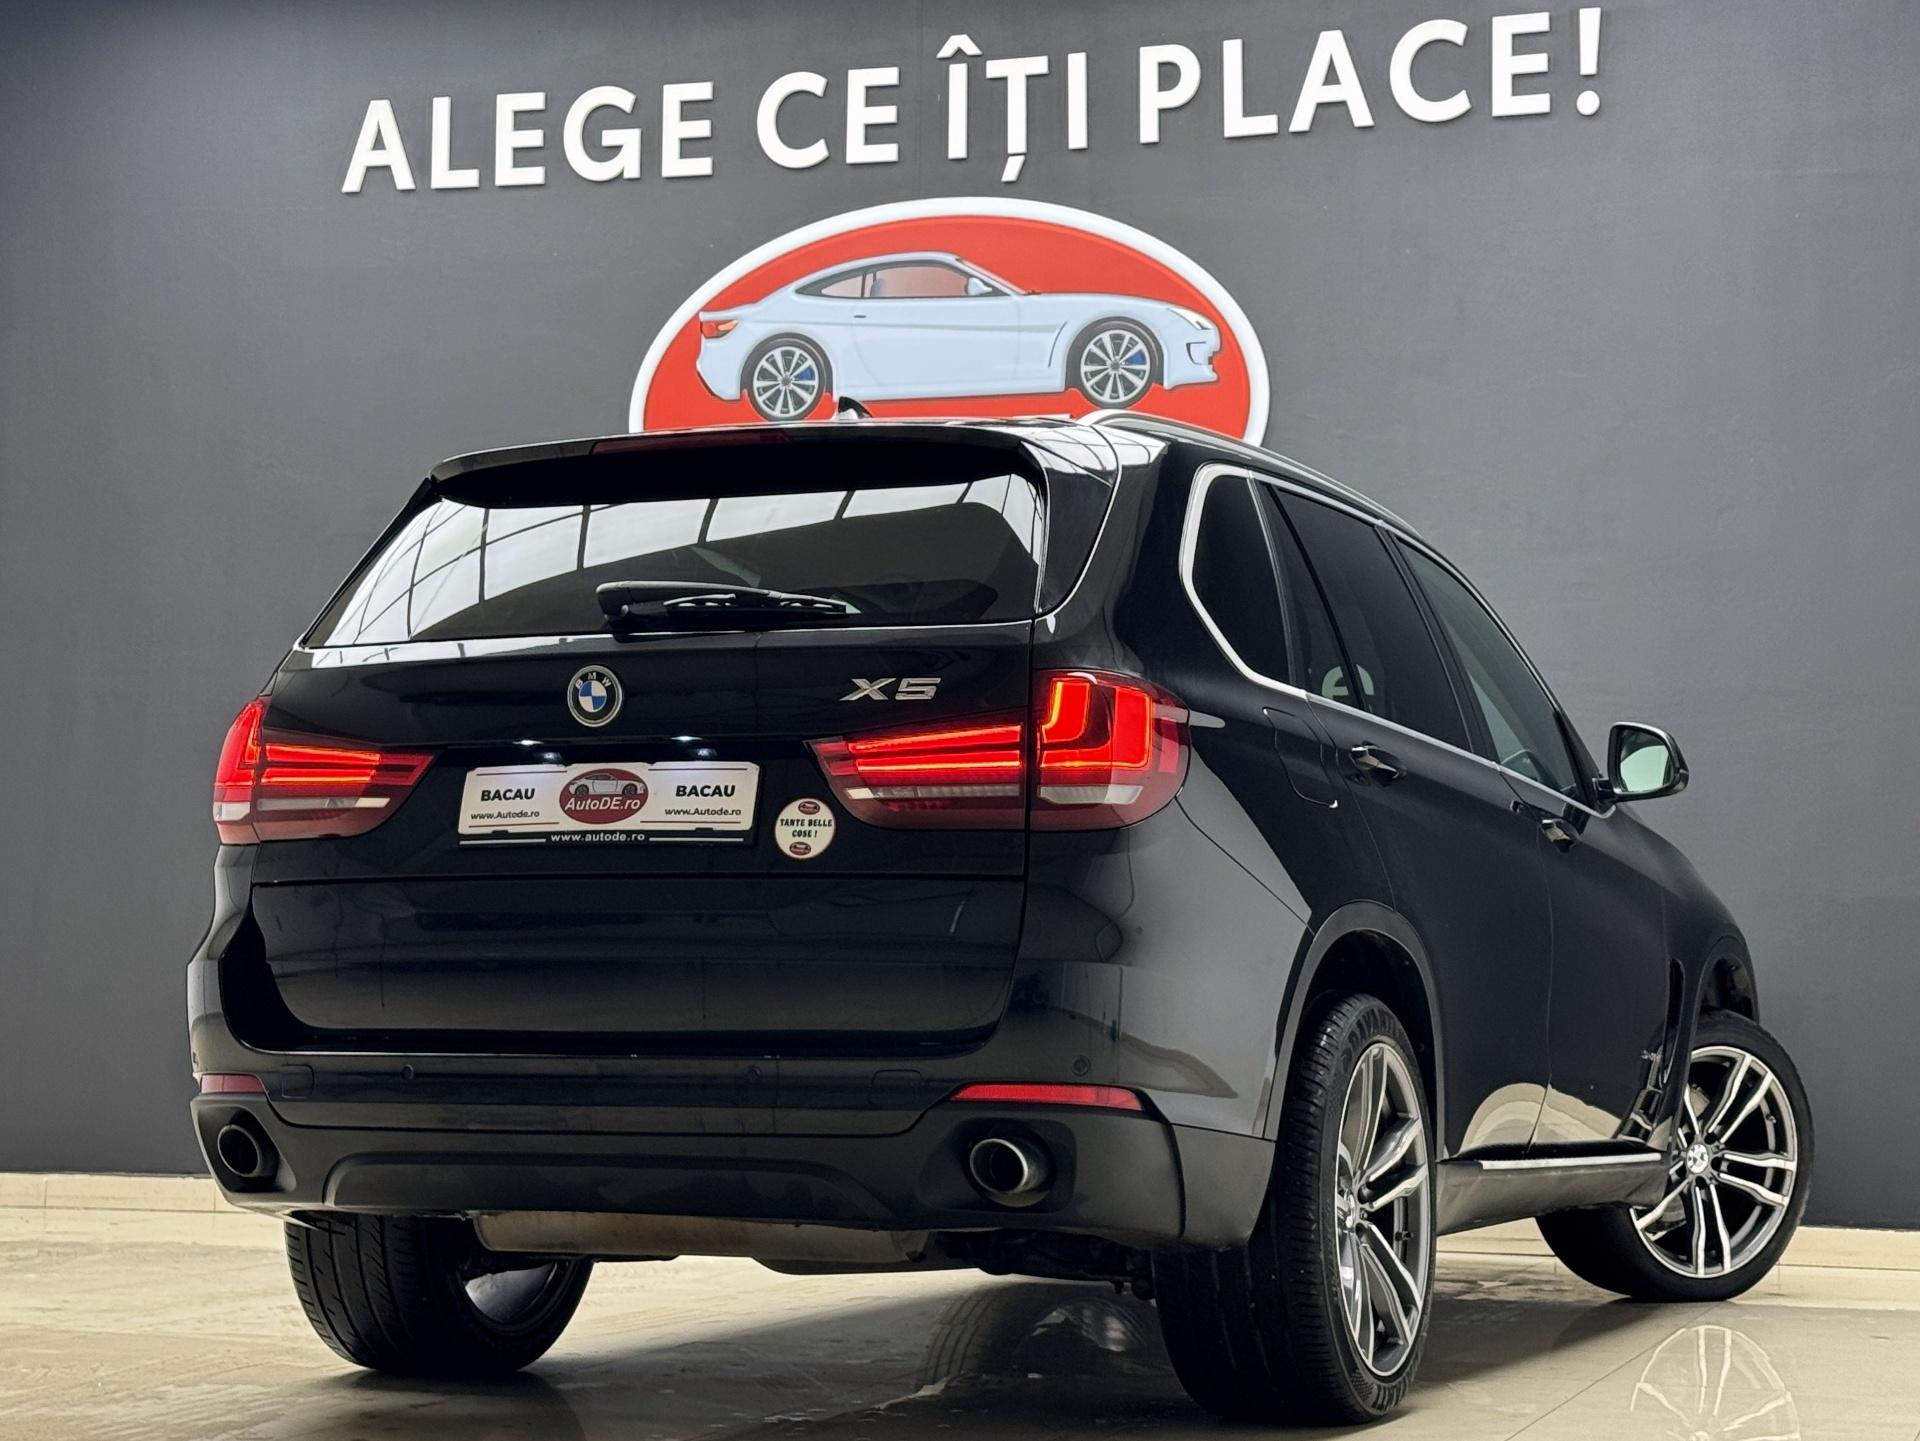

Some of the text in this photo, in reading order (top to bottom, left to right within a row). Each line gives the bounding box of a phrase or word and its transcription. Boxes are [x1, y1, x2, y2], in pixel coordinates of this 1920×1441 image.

[342, 7, 1602, 193] ALEGE CE ÎȚI PLACE!
[575, 672, 612, 689] BMW
[840, 677, 942, 701] X5
[480, 788, 536, 802] BACAU
[676, 785, 736, 798] BACAU
[565, 797, 641, 811] AutoDE.ro
[470, 809, 540, 820] www.Autode.ro
[664, 807, 742, 816] www.Autode.ro
[780, 818, 832, 827] TANTE BELLE
[550, 831, 646, 842] www.autode.ro
[792, 829, 812, 838] COSE
